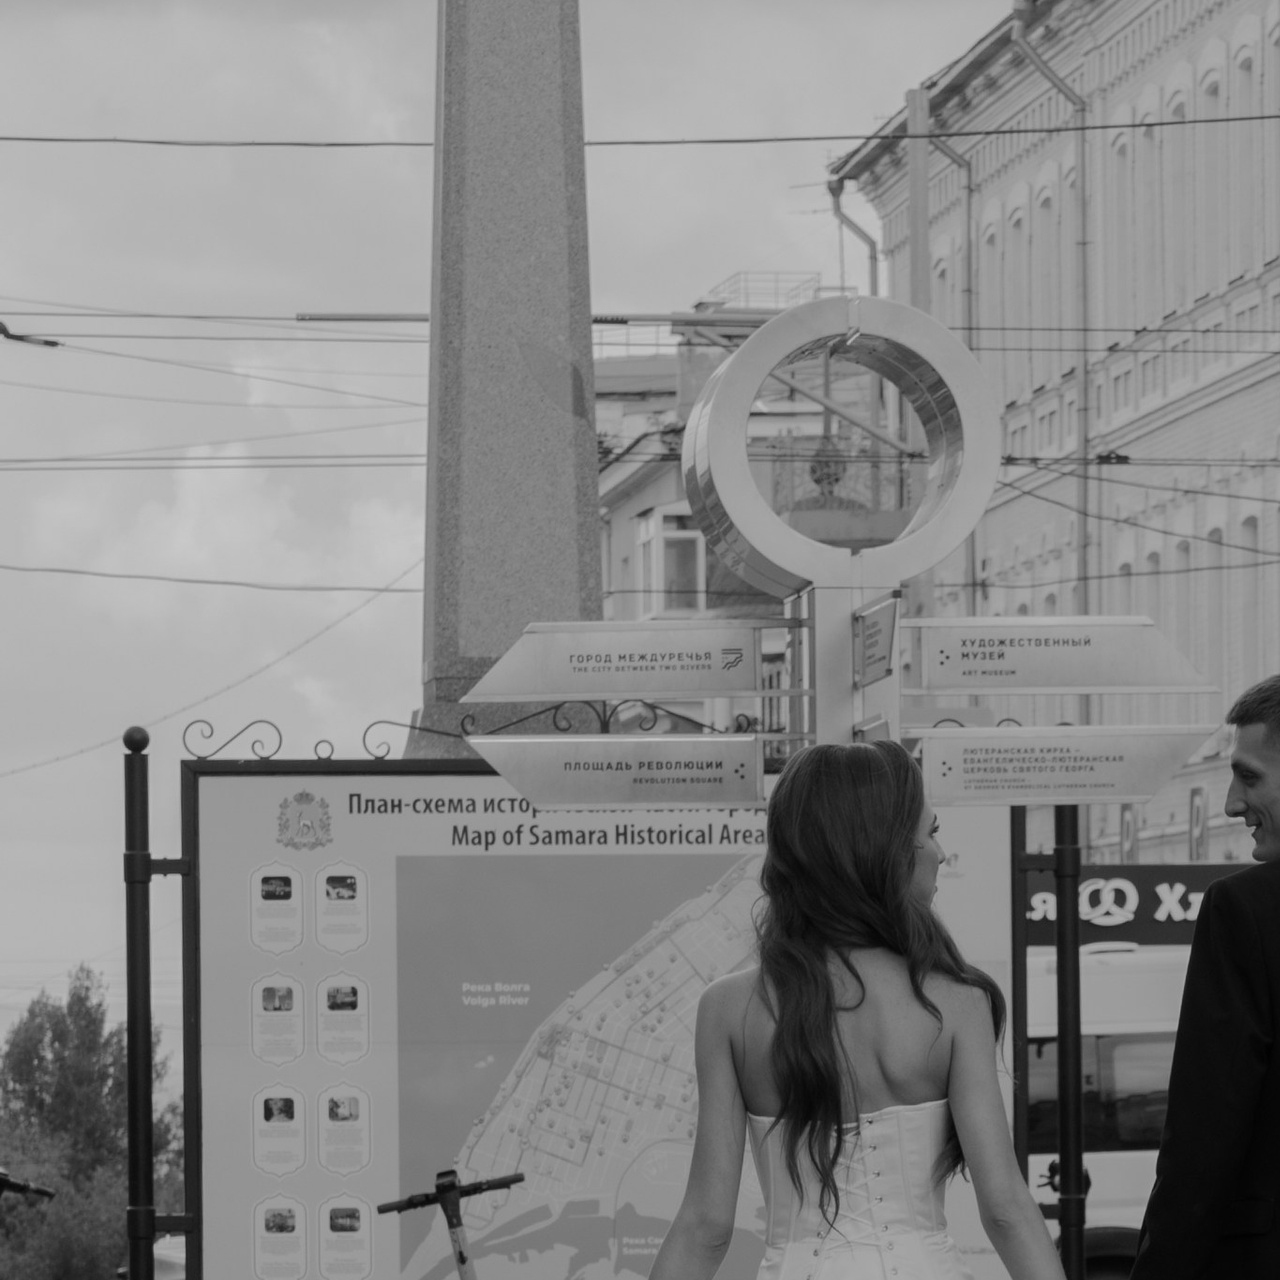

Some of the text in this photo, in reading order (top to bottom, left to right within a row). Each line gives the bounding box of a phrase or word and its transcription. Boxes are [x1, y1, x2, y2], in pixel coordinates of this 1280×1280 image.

[960, 635, 1092, 648] ХУДОЖЕСТВЕННЫЙ
[569, 651, 712, 664] ГОРОД МЕЖДУРЕЧЬЯ
[960, 649, 1006, 661] МУЗЕЙ
[961, 669, 978, 677] ART
[563, 760, 724, 772] ПЛОЩАДЬ РЕВОЛЮЦИИ
[632, 776, 687, 785] REVOLUTION
[348, 793, 477, 815] План-схема
[451, 823, 765, 851] Map of Samara Historical Area
[461, 994, 496, 1008] Volga
